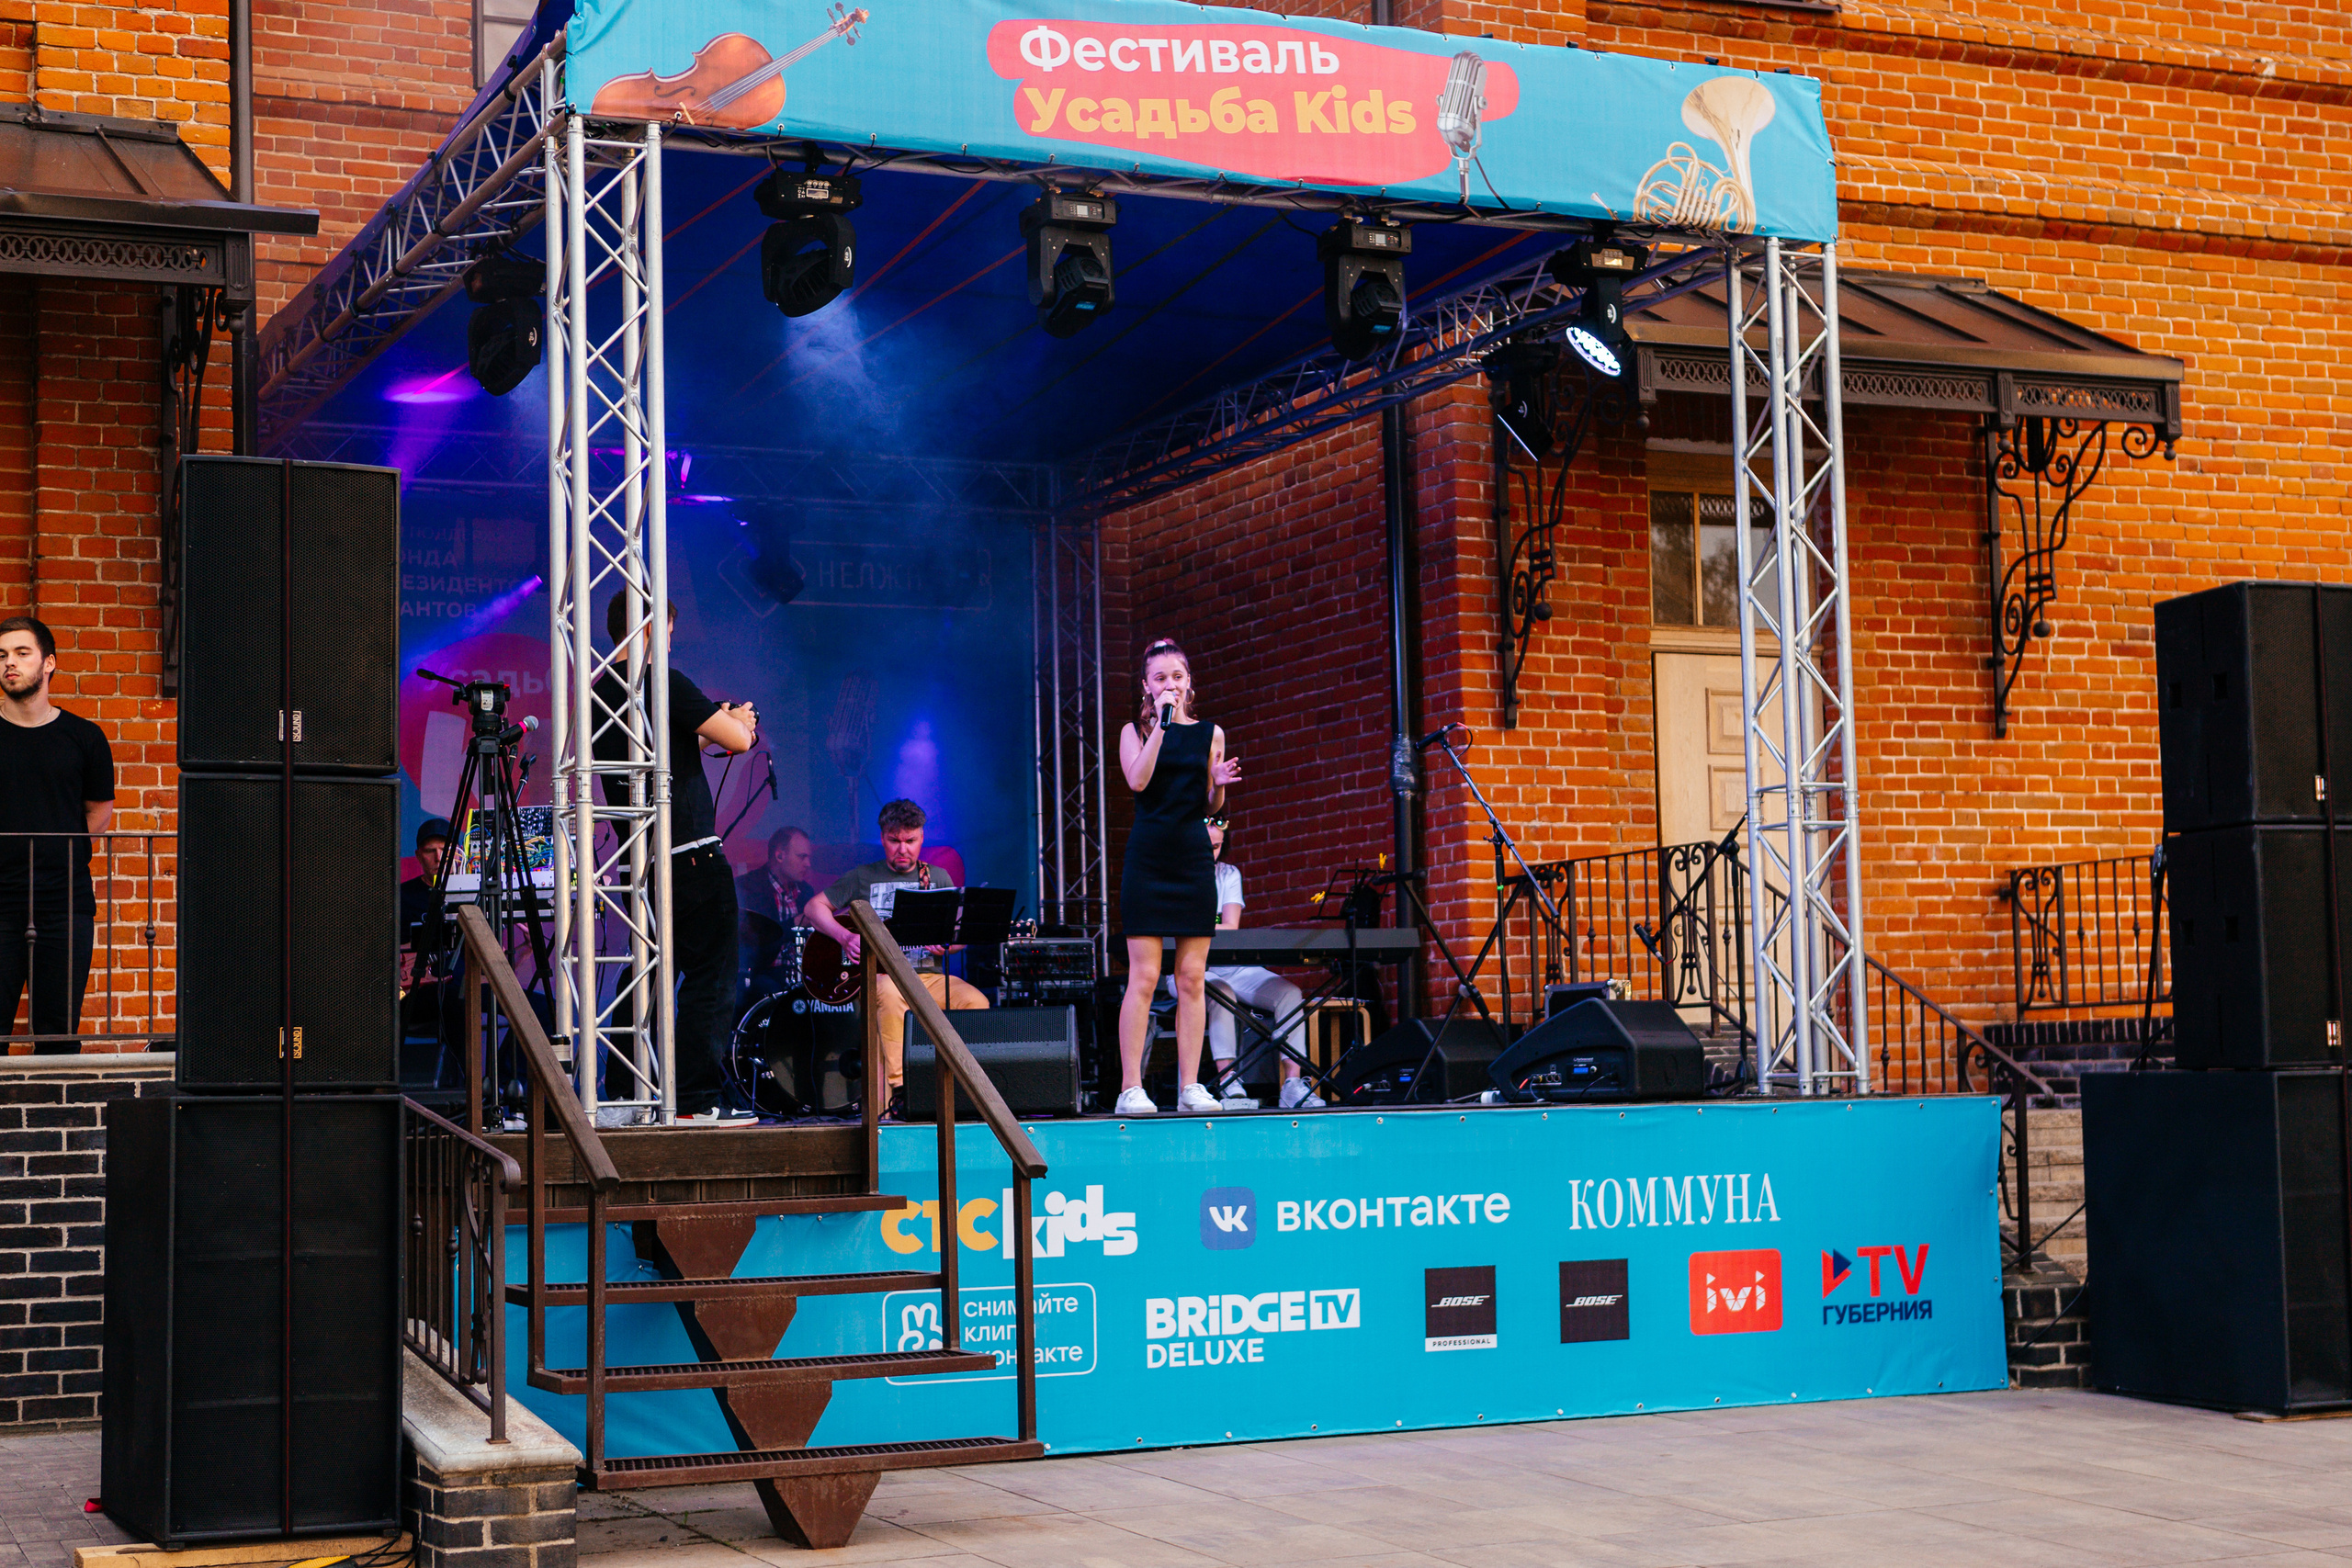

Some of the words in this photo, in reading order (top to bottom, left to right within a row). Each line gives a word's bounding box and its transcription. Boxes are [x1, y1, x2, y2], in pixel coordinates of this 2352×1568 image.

[1019, 25, 1340, 74] Фестиваль
[1022, 85, 1279, 140] Усадьба
[1295, 85, 1417, 135] Kids
[1568, 1172, 1781, 1231] КОММУНА
[1857, 1243, 1929, 1298] TV
[1314, 1292, 1355, 1325] TV
[1430, 1294, 1490, 1308] BOSE
[1565, 1294, 1623, 1308] BOSE
[1822, 1299, 1933, 1325] ГУБЕРНИЯ
[1146, 1337, 1264, 1369] DELUXE
[1432, 1337, 1491, 1348] PROFESSIONAL
